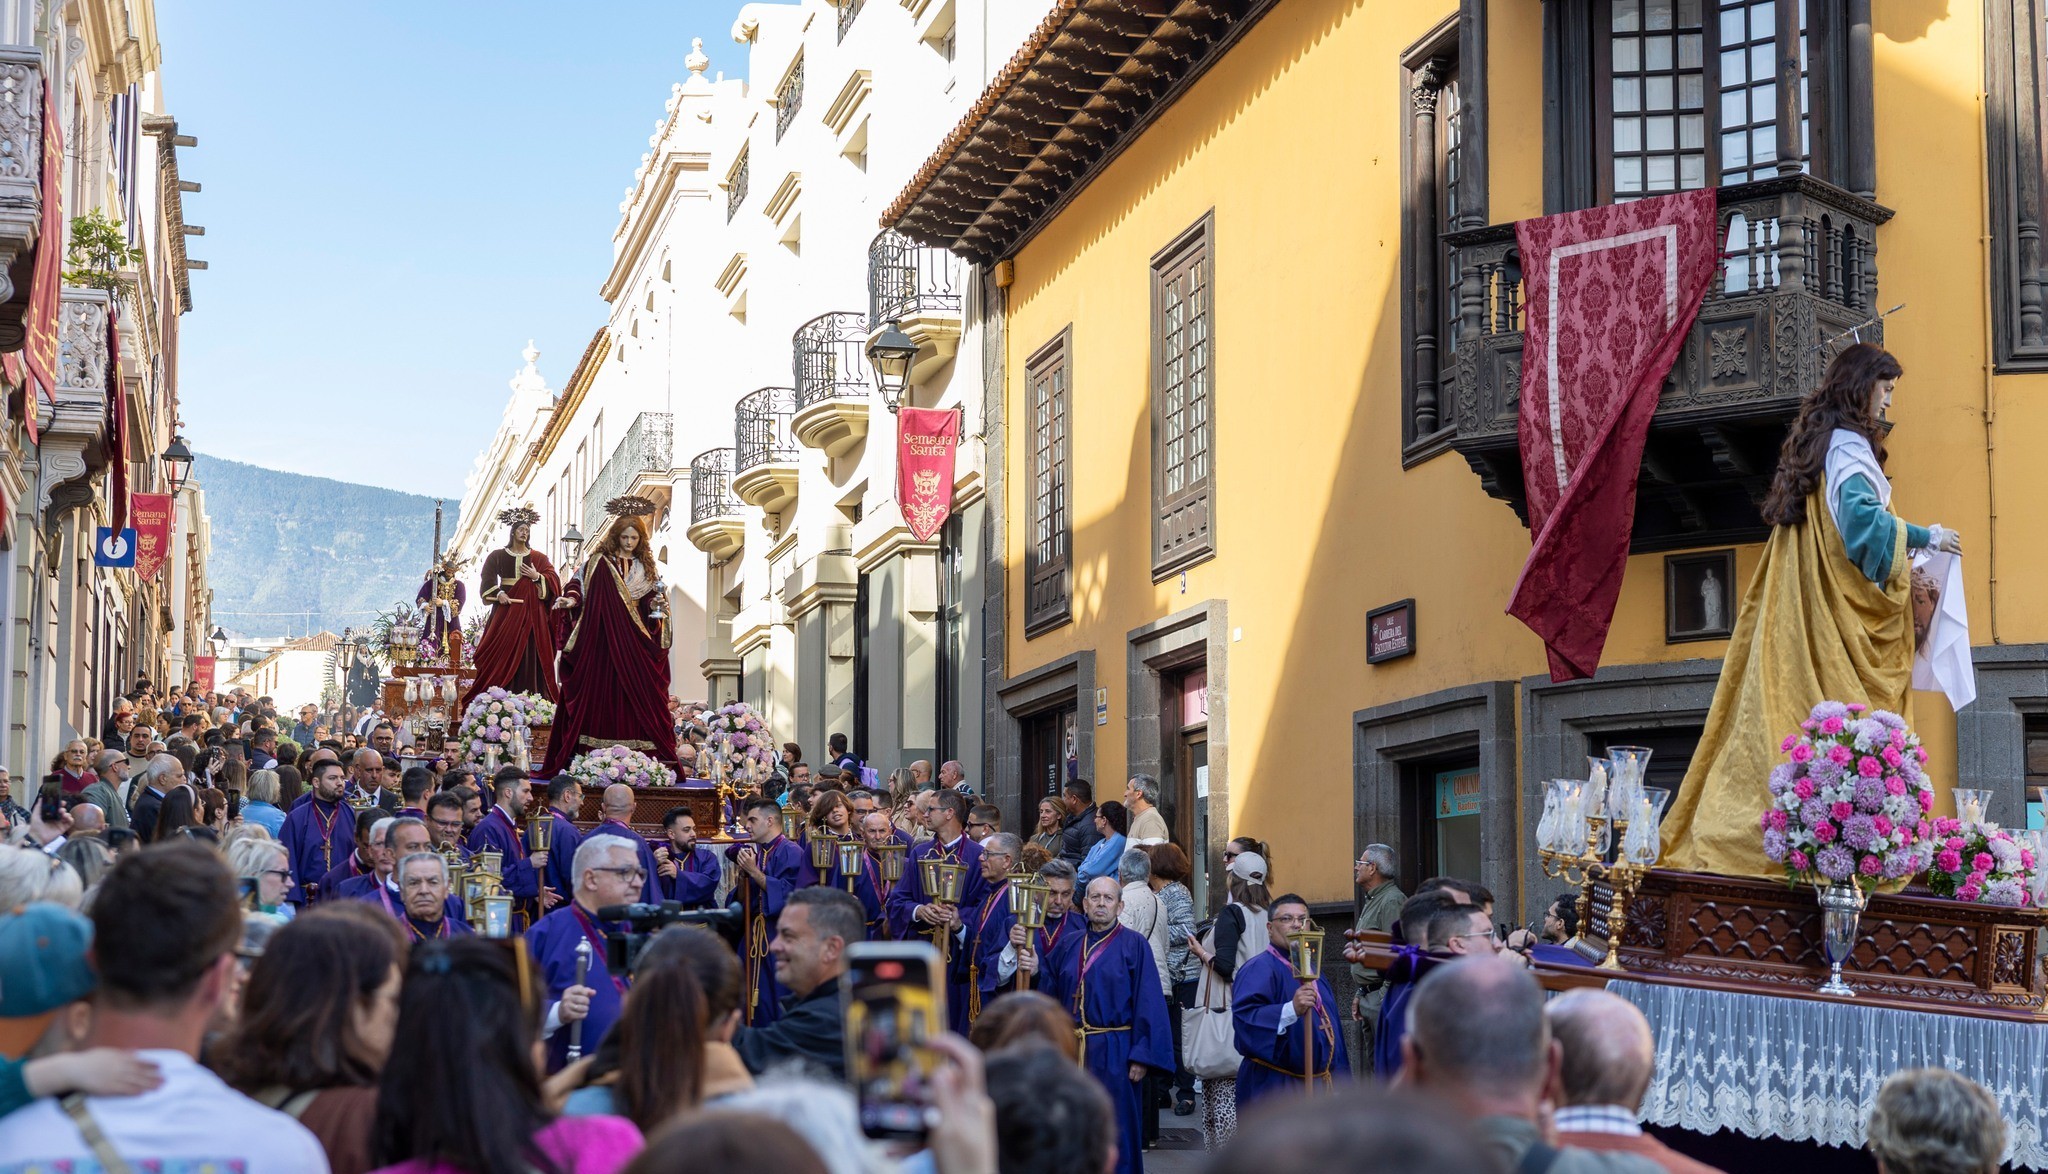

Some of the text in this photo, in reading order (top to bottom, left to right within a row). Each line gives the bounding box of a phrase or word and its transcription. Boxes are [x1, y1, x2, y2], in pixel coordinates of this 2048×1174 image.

[903, 432, 953, 446] Semana
[910, 445, 946, 456] Santa
[132, 509, 167, 519] Semana
[136, 517, 162, 526] Santa
